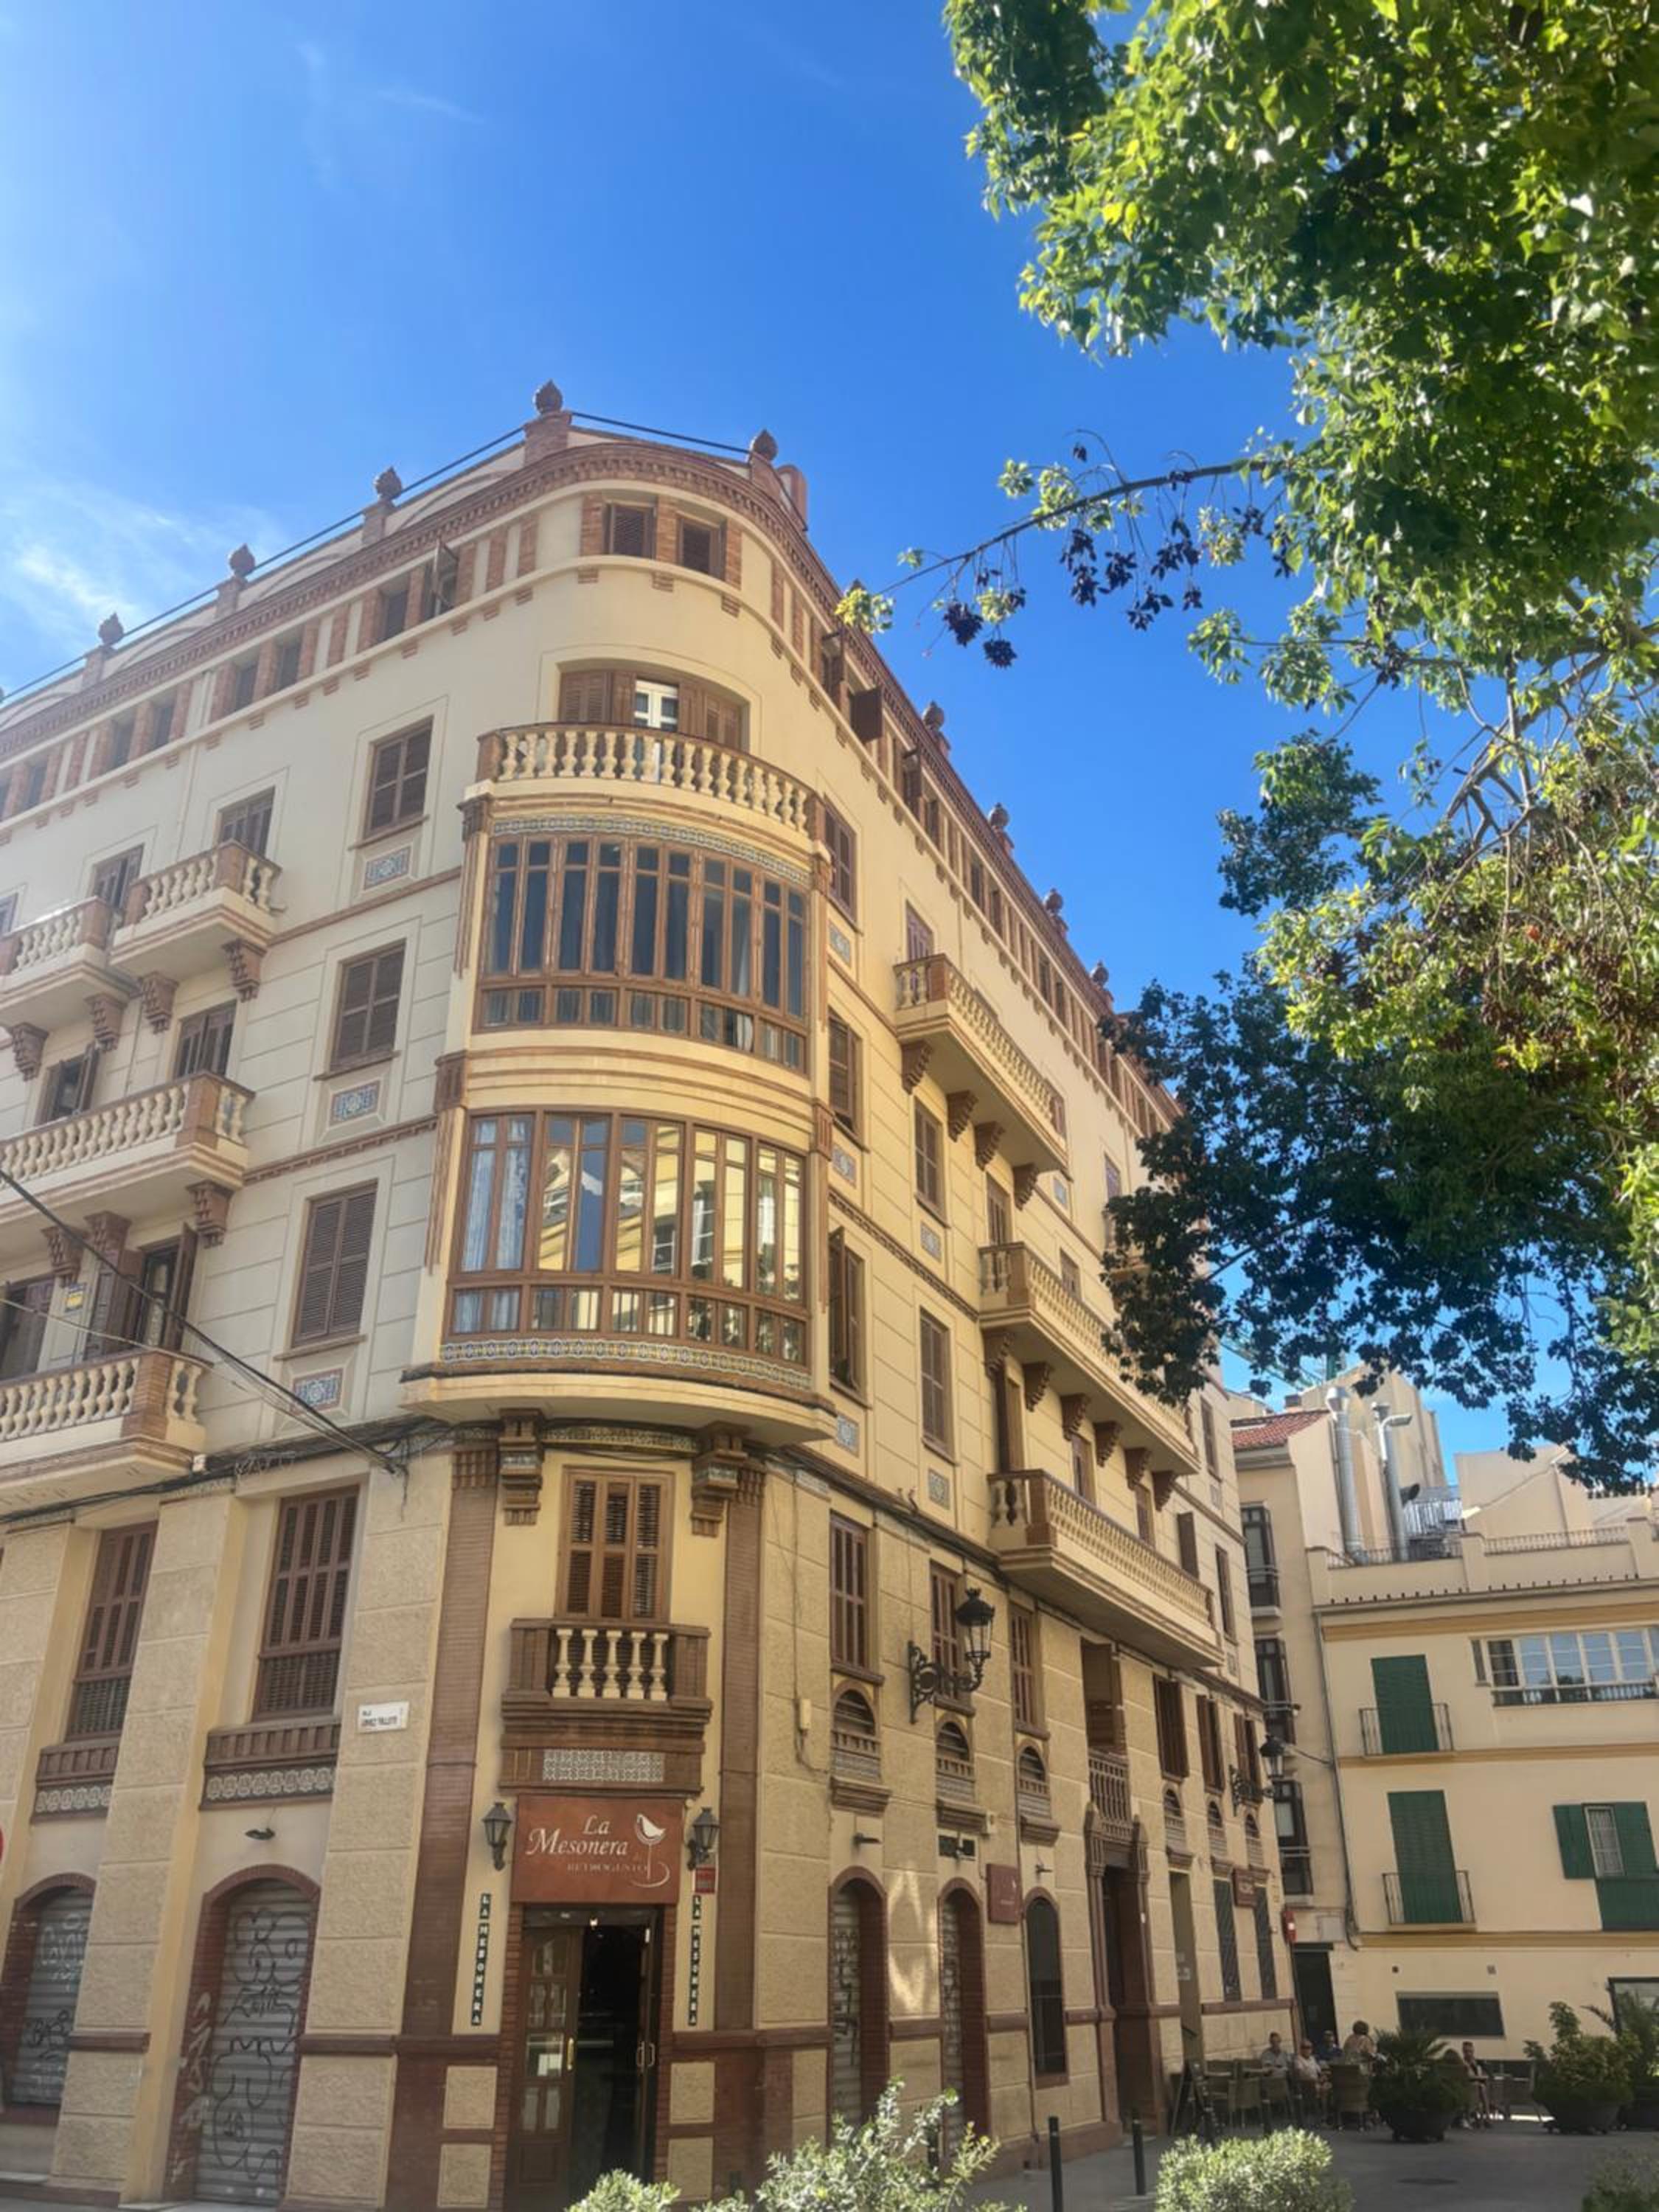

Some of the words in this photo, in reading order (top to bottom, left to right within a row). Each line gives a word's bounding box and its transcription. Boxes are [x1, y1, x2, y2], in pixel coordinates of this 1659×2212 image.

[582, 1815, 611, 1834] La
[525, 1828, 627, 1856] Mesonera
[481, 1895, 490, 1918] LA
